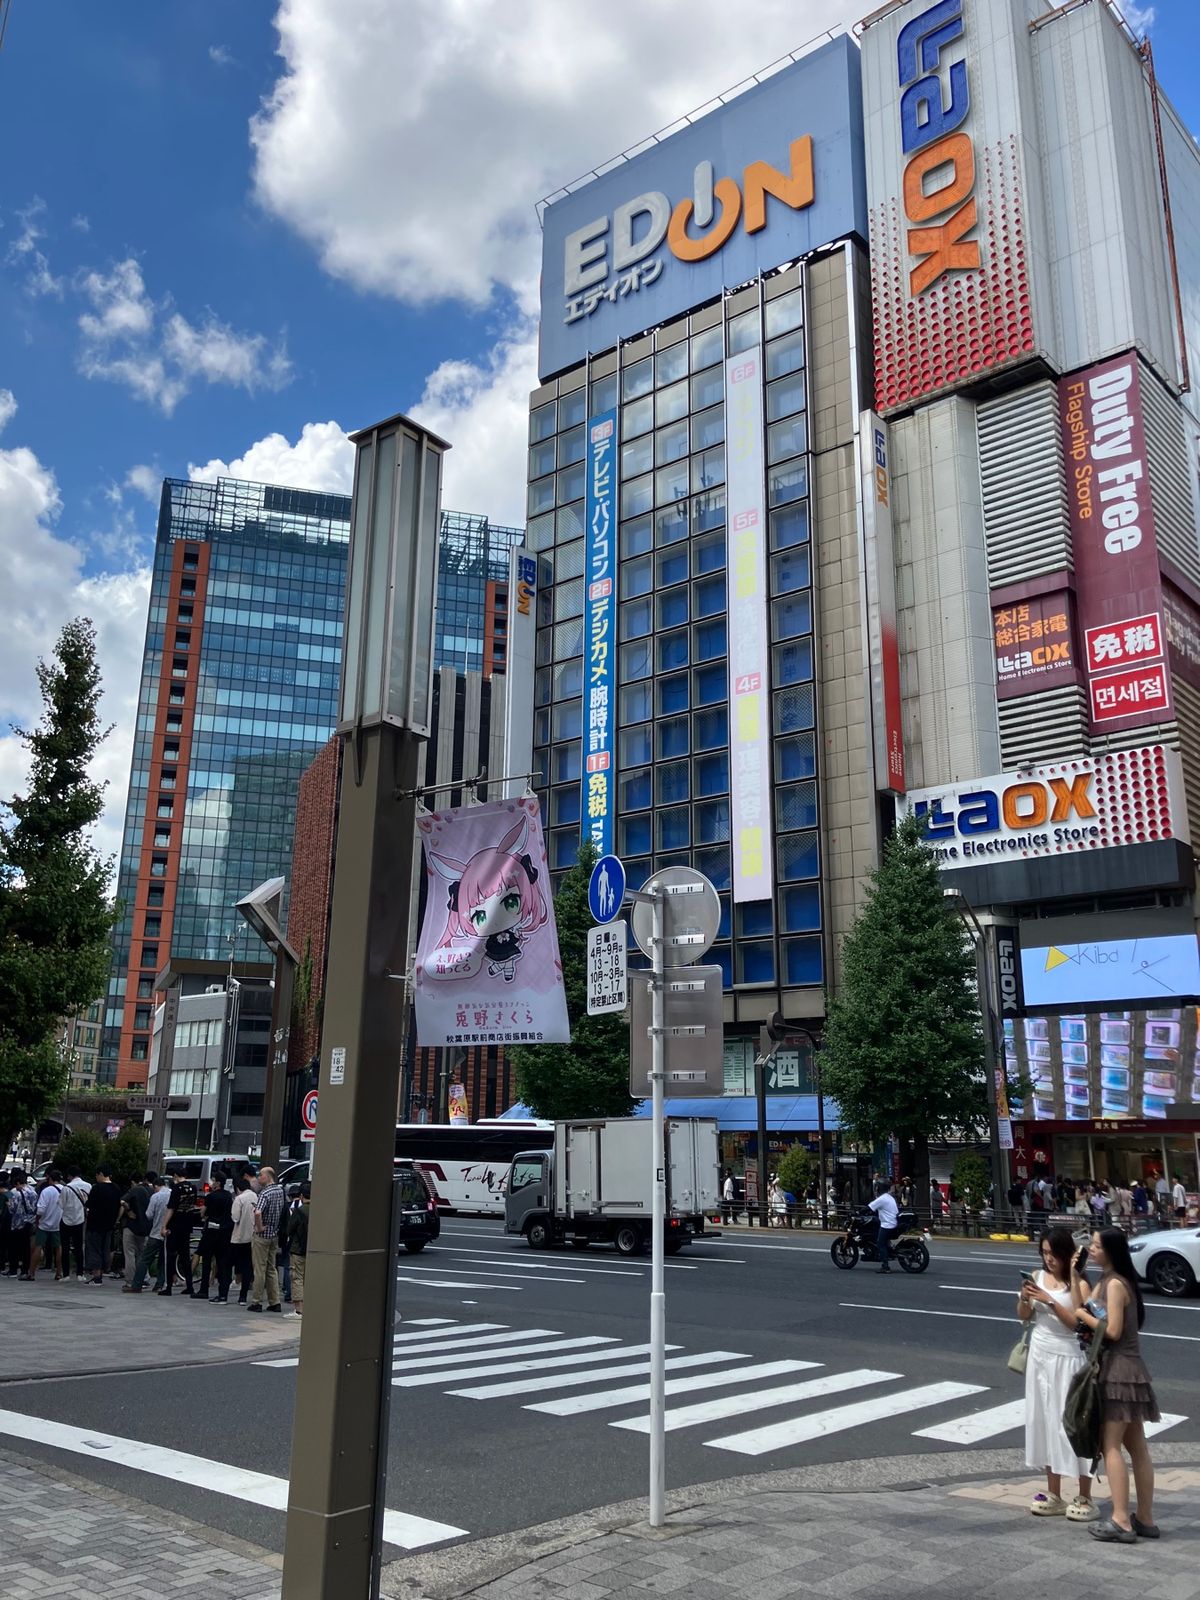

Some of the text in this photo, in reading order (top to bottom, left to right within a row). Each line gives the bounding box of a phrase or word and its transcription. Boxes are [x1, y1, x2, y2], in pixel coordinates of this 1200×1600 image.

[564, 134, 815, 297] EDION
[563, 259, 664, 325] エディオン
[1066, 382, 1092, 519] Flagship Store
[1089, 365, 1143, 555] Duty Free
[735, 513, 758, 531] 5F
[517, 557, 536, 615] EDION
[994, 604, 1029, 627] 本店
[995, 613, 1068, 647] 総合家電
[1092, 623, 1155, 662] 免税
[737, 676, 760, 692] 4F
[998, 671, 1017, 681] Home
[1054, 660, 1072, 668] Store
[1095, 676, 1162, 709] 면세점
[590, 756, 606, 771] 1F
[588, 773, 607, 818] 免税
[963, 832, 1049, 857] Electronics
[1054, 825, 1099, 843] Store
[767, 1051, 800, 1088] 酒
